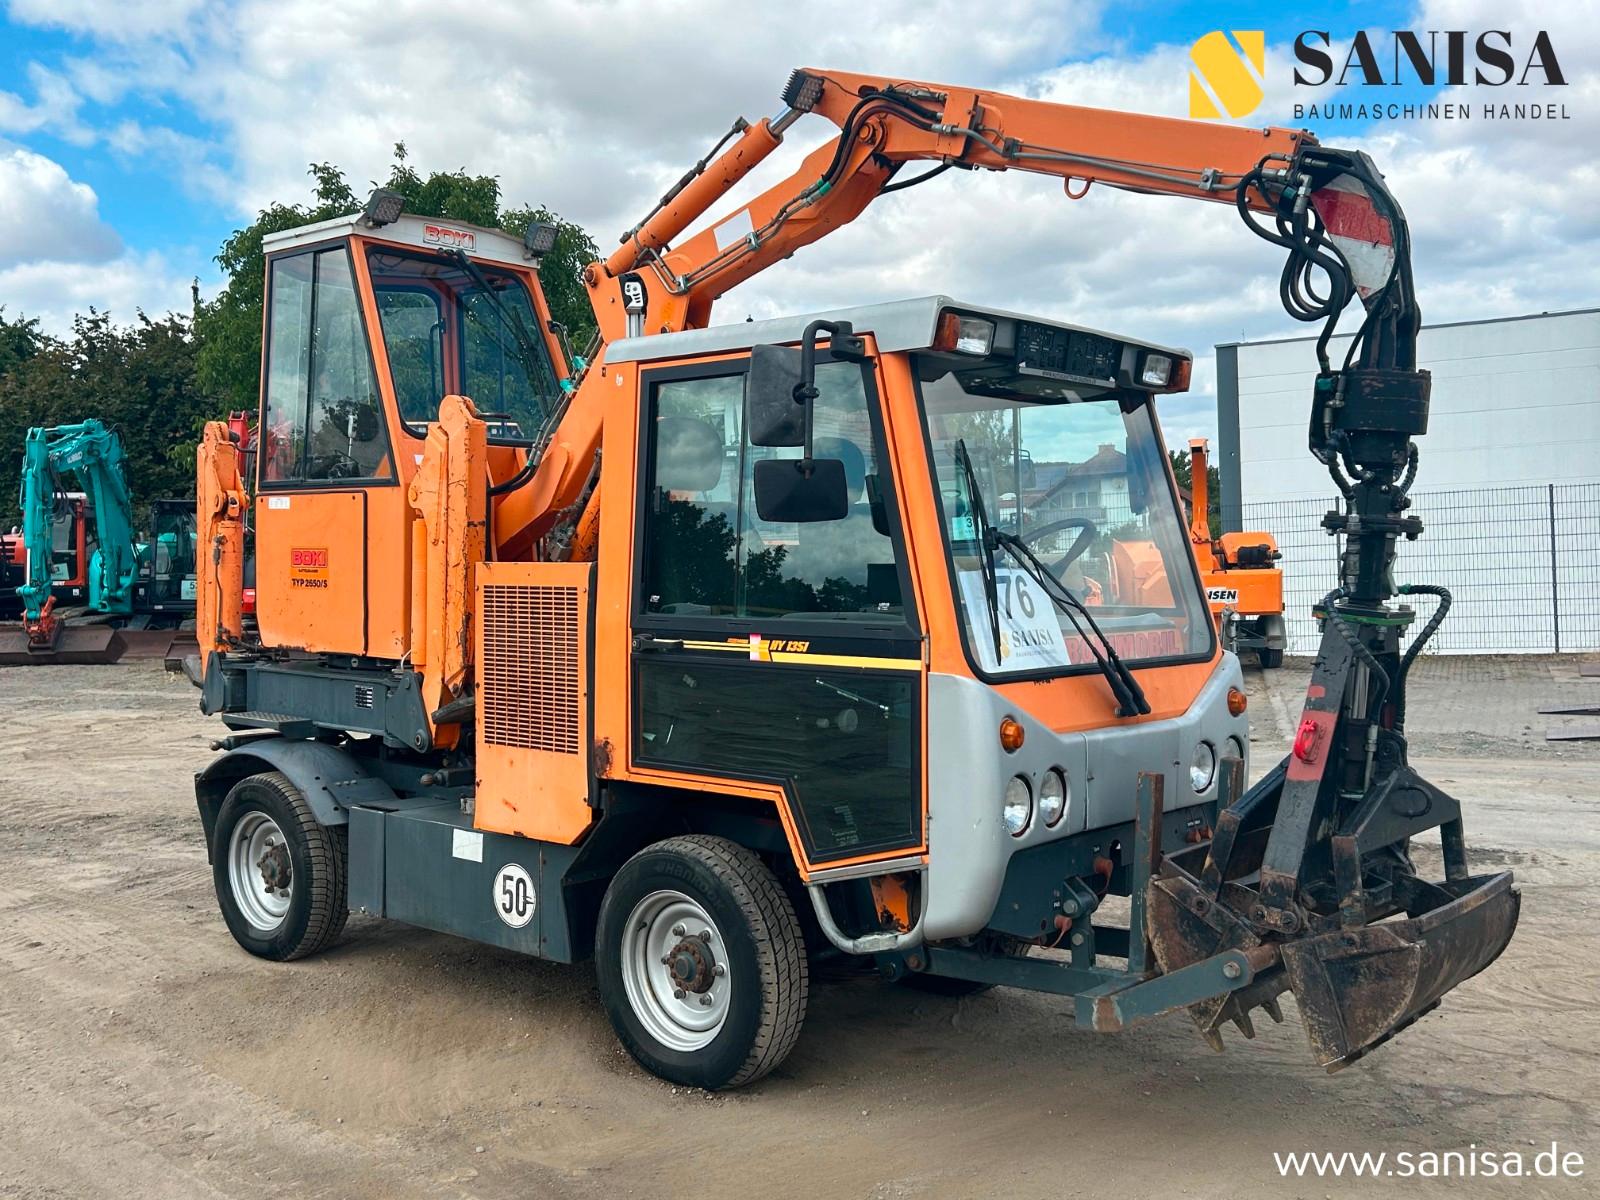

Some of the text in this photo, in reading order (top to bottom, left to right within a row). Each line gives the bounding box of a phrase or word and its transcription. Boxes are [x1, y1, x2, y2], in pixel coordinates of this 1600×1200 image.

[425, 225, 474, 249] BOKI
[293, 550, 326, 566] BOKI
[292, 578, 304, 588] TYP
[995, 575, 1035, 619] 76
[1012, 628, 1054, 648] SANISA
[502, 874, 528, 918] 50
